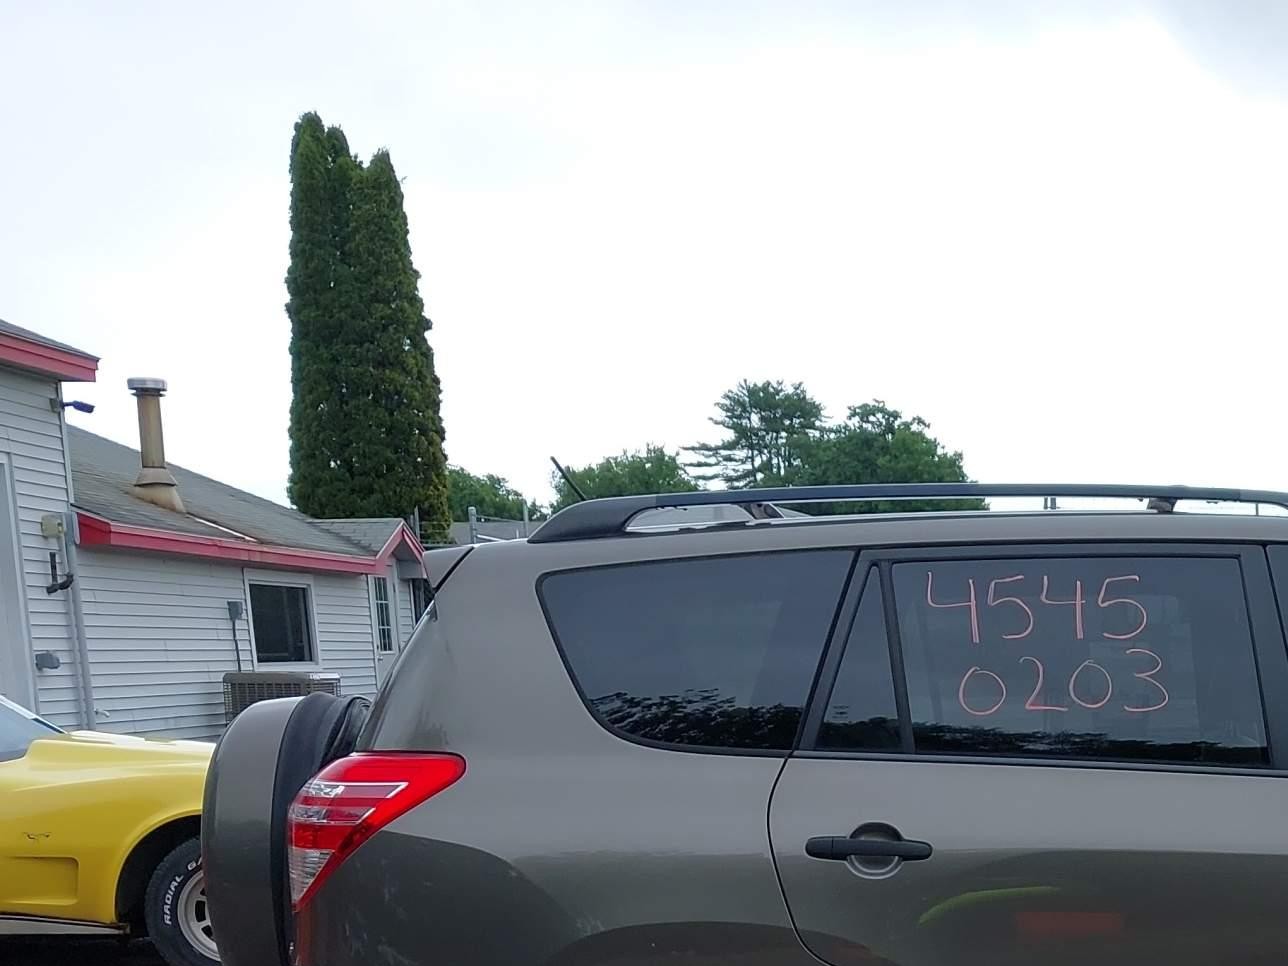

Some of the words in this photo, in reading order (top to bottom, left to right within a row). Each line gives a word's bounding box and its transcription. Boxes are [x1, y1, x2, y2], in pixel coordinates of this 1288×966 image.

[927, 571, 1147, 643] 4545
[958, 648, 1169, 715] 0203
[163, 875, 184, 925] RADIAL
